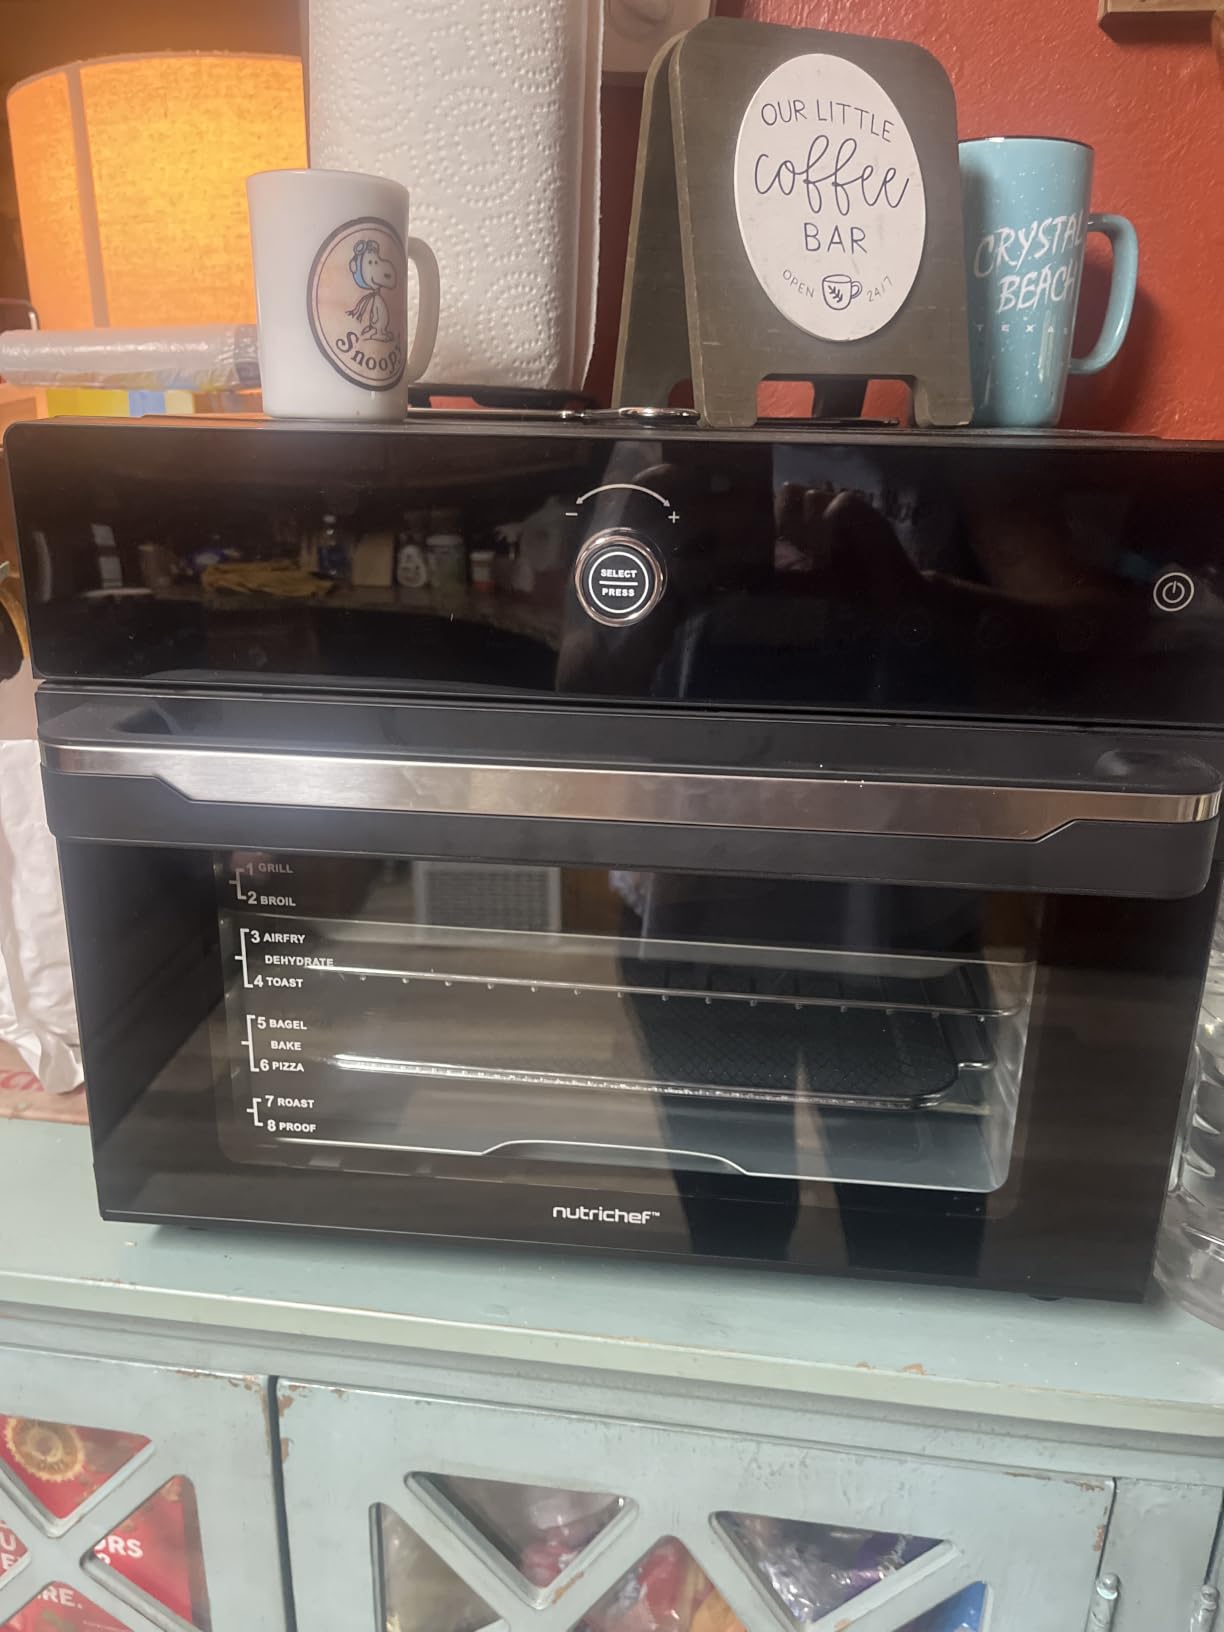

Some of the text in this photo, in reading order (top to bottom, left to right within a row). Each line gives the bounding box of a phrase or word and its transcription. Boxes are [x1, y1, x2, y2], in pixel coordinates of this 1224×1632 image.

[761, 99, 894, 142] OUR LITTLE
[754, 134, 910, 216] coffee
[803, 222, 868, 254] BAR
[782, 269, 893, 303] OPEN 24/7
[996, 259, 1077, 314] BEACH
[600, 568, 637, 578] SELECT
[601, 587, 635, 596] PRESS
[258, 863, 293, 873] GRILL
[247, 891, 296, 906] 2 BROIL
[250, 930, 305, 944] 3 AIRFRY
[265, 955, 334, 967] DEHYDRATE
[253, 974, 303, 987] 4 TOAST
[257, 1016, 307, 1030] 5 BAGEL
[270, 1040, 301, 1050] BAKE
[260, 1059, 304, 1072] 6 PIZZA
[265, 1095, 314, 1108] 7 ROAST
[267, 1119, 316, 1132] 8 PROOF
